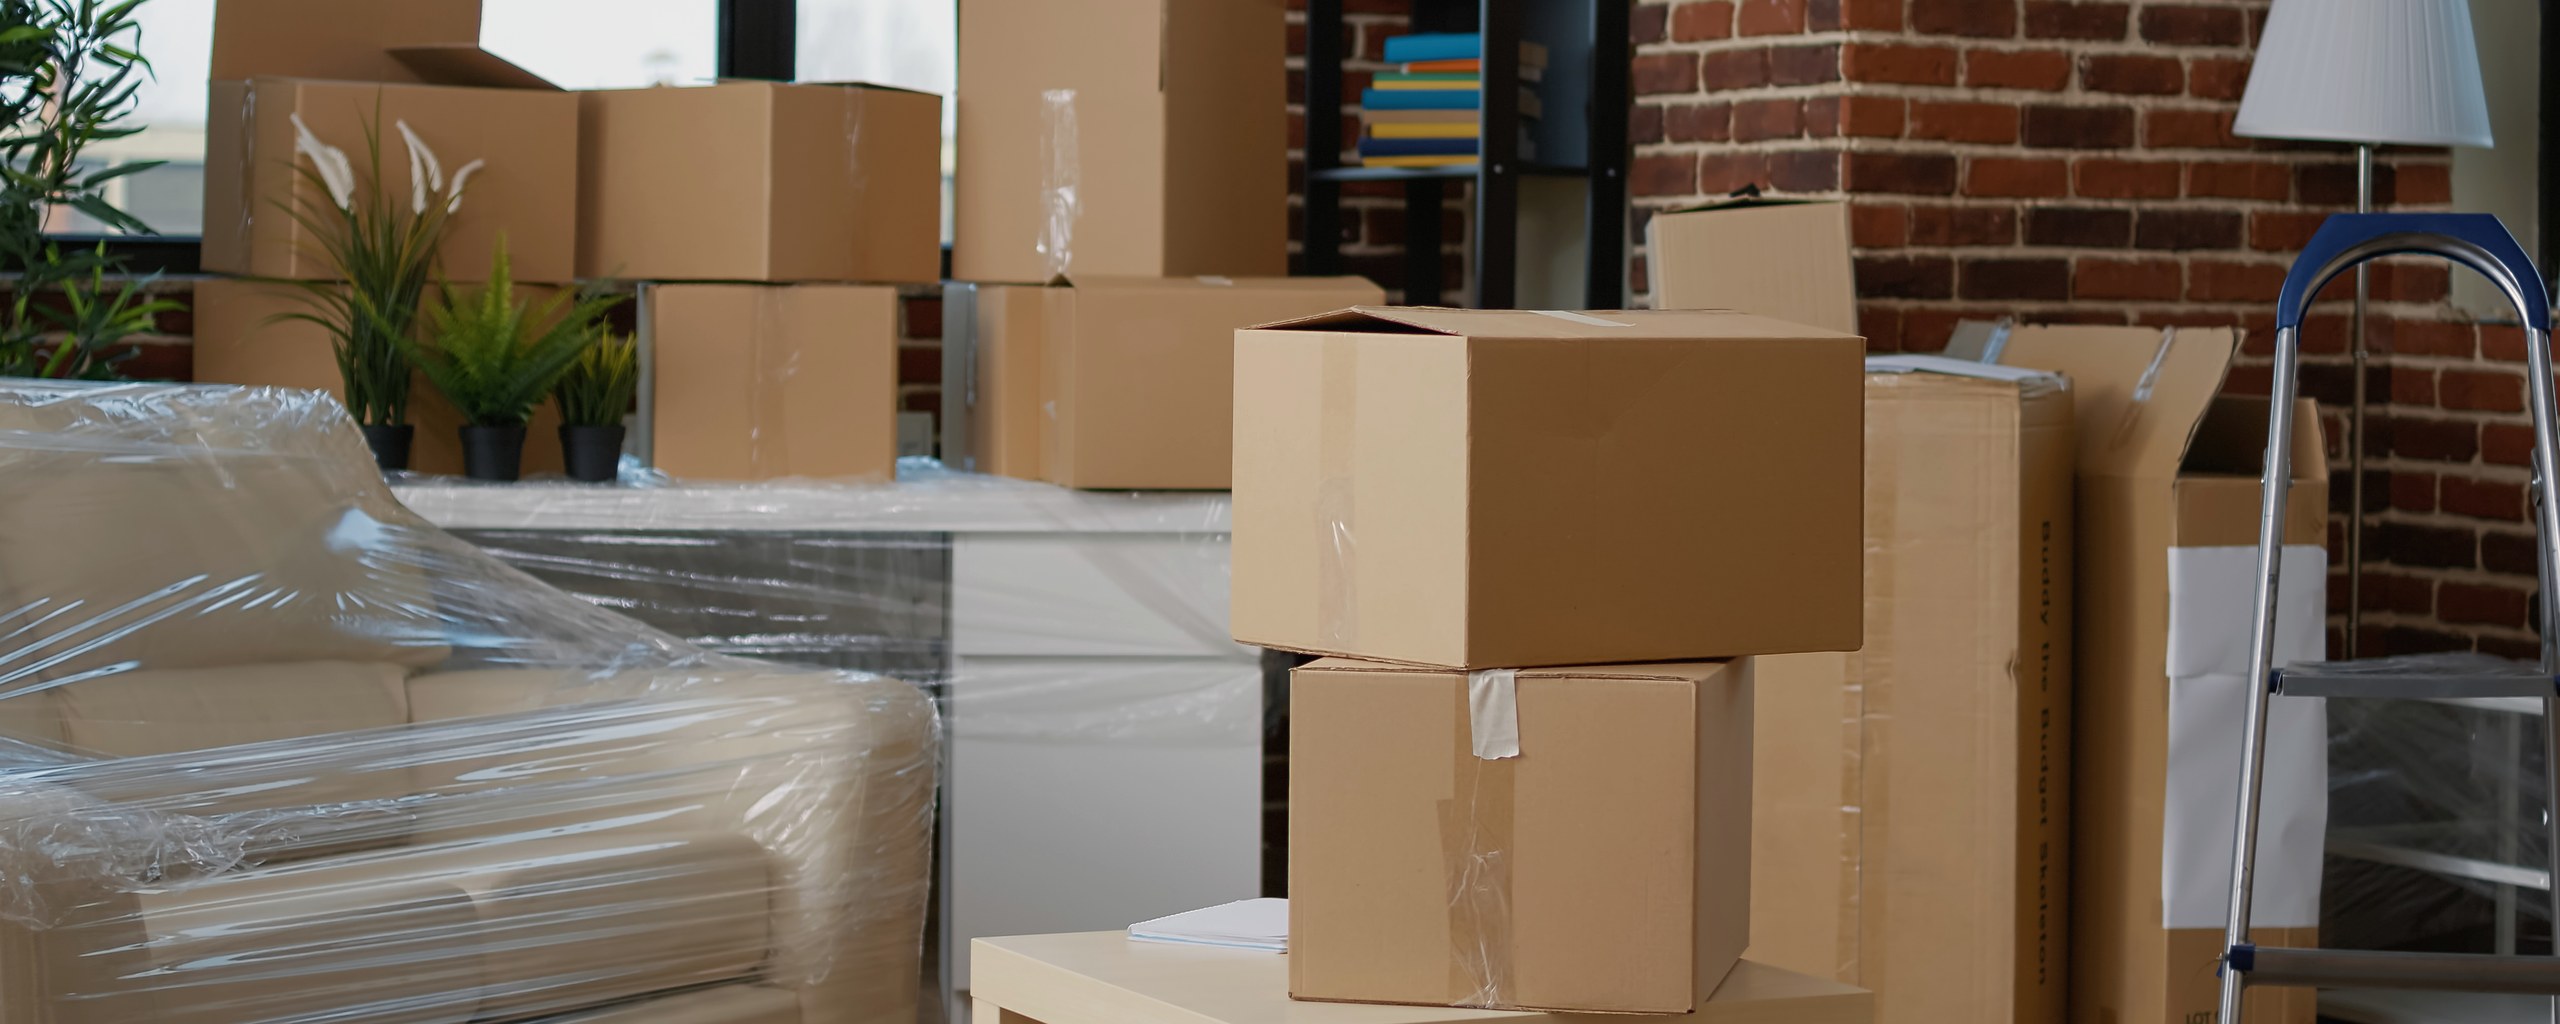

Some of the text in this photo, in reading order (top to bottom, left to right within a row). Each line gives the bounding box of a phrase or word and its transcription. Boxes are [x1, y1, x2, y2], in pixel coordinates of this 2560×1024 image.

[2038, 520, 2051, 985] Buddy the Budget Skeleton
